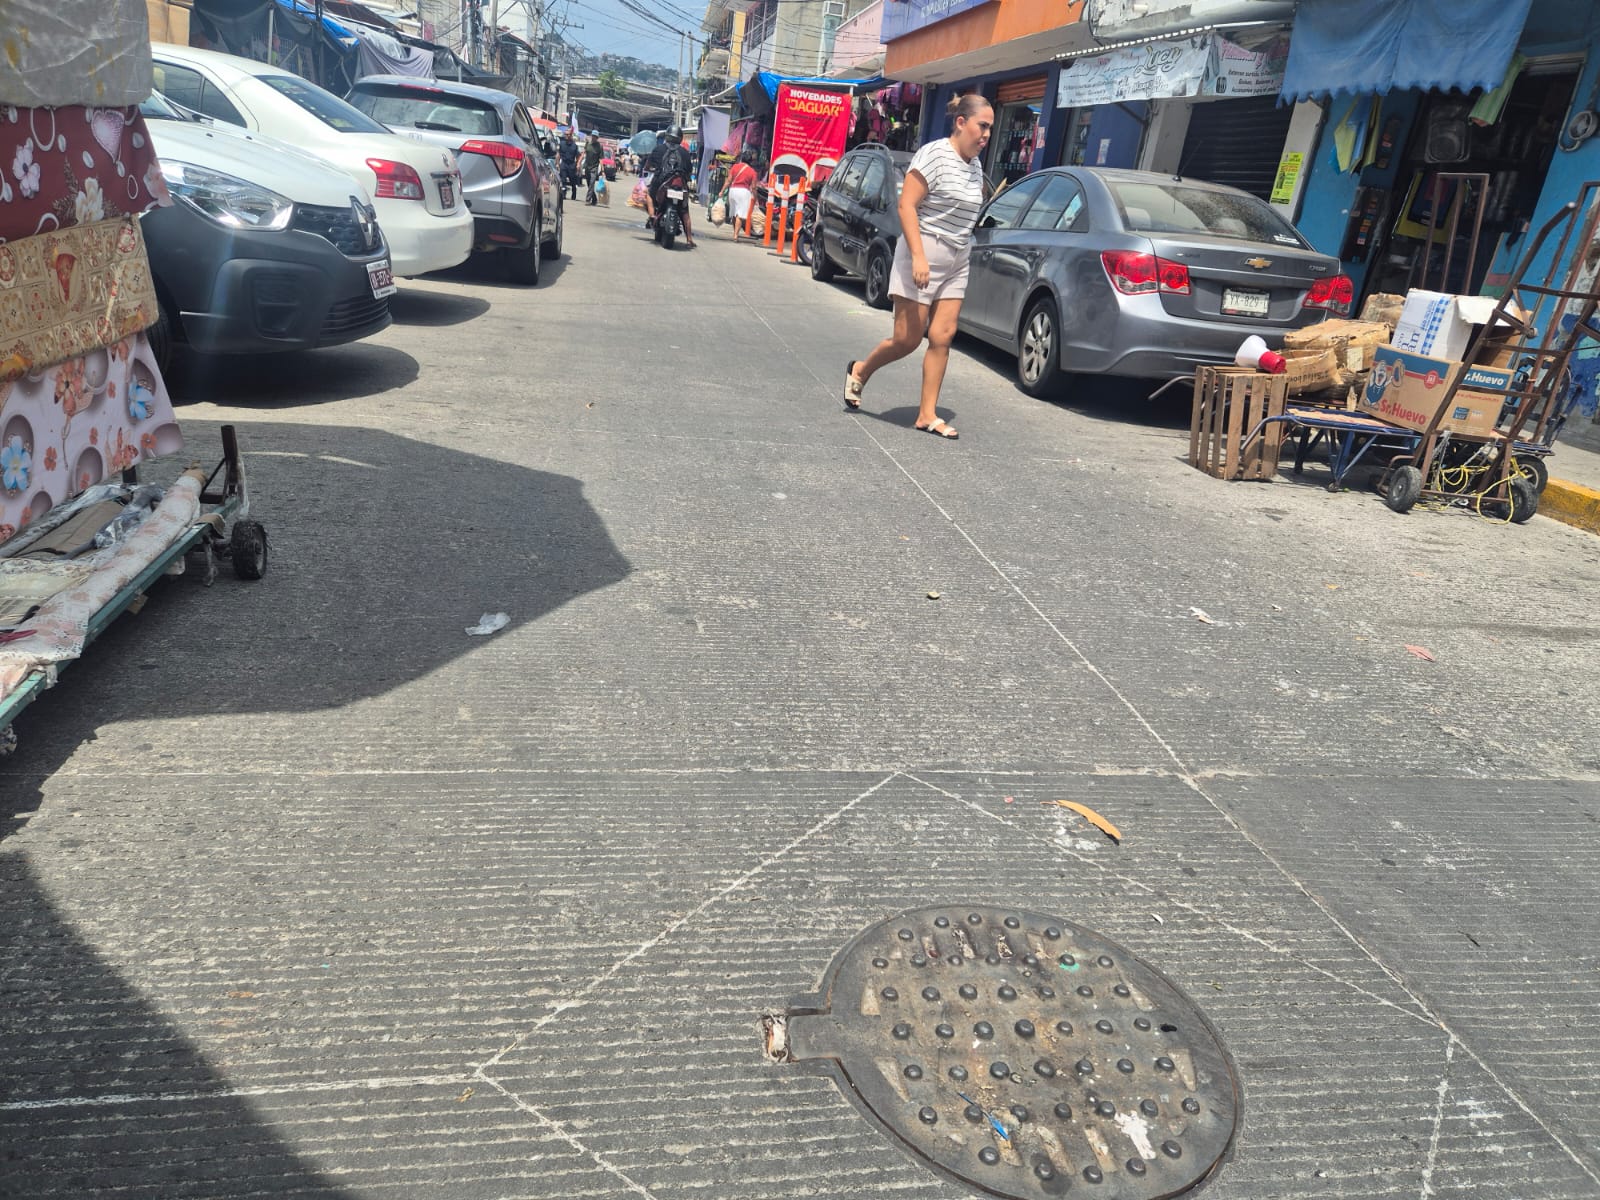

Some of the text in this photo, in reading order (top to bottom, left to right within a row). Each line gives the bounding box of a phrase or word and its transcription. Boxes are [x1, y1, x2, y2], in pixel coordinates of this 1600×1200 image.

[1133, 45, 1184, 79] Lucy
[790, 89, 842, 104] NOVEDADES
[785, 98, 845, 117] "JAGUAR"
[1463, 372, 1504, 386] r.Huevo
[1380, 398, 1427, 426] Sr.Huevo
